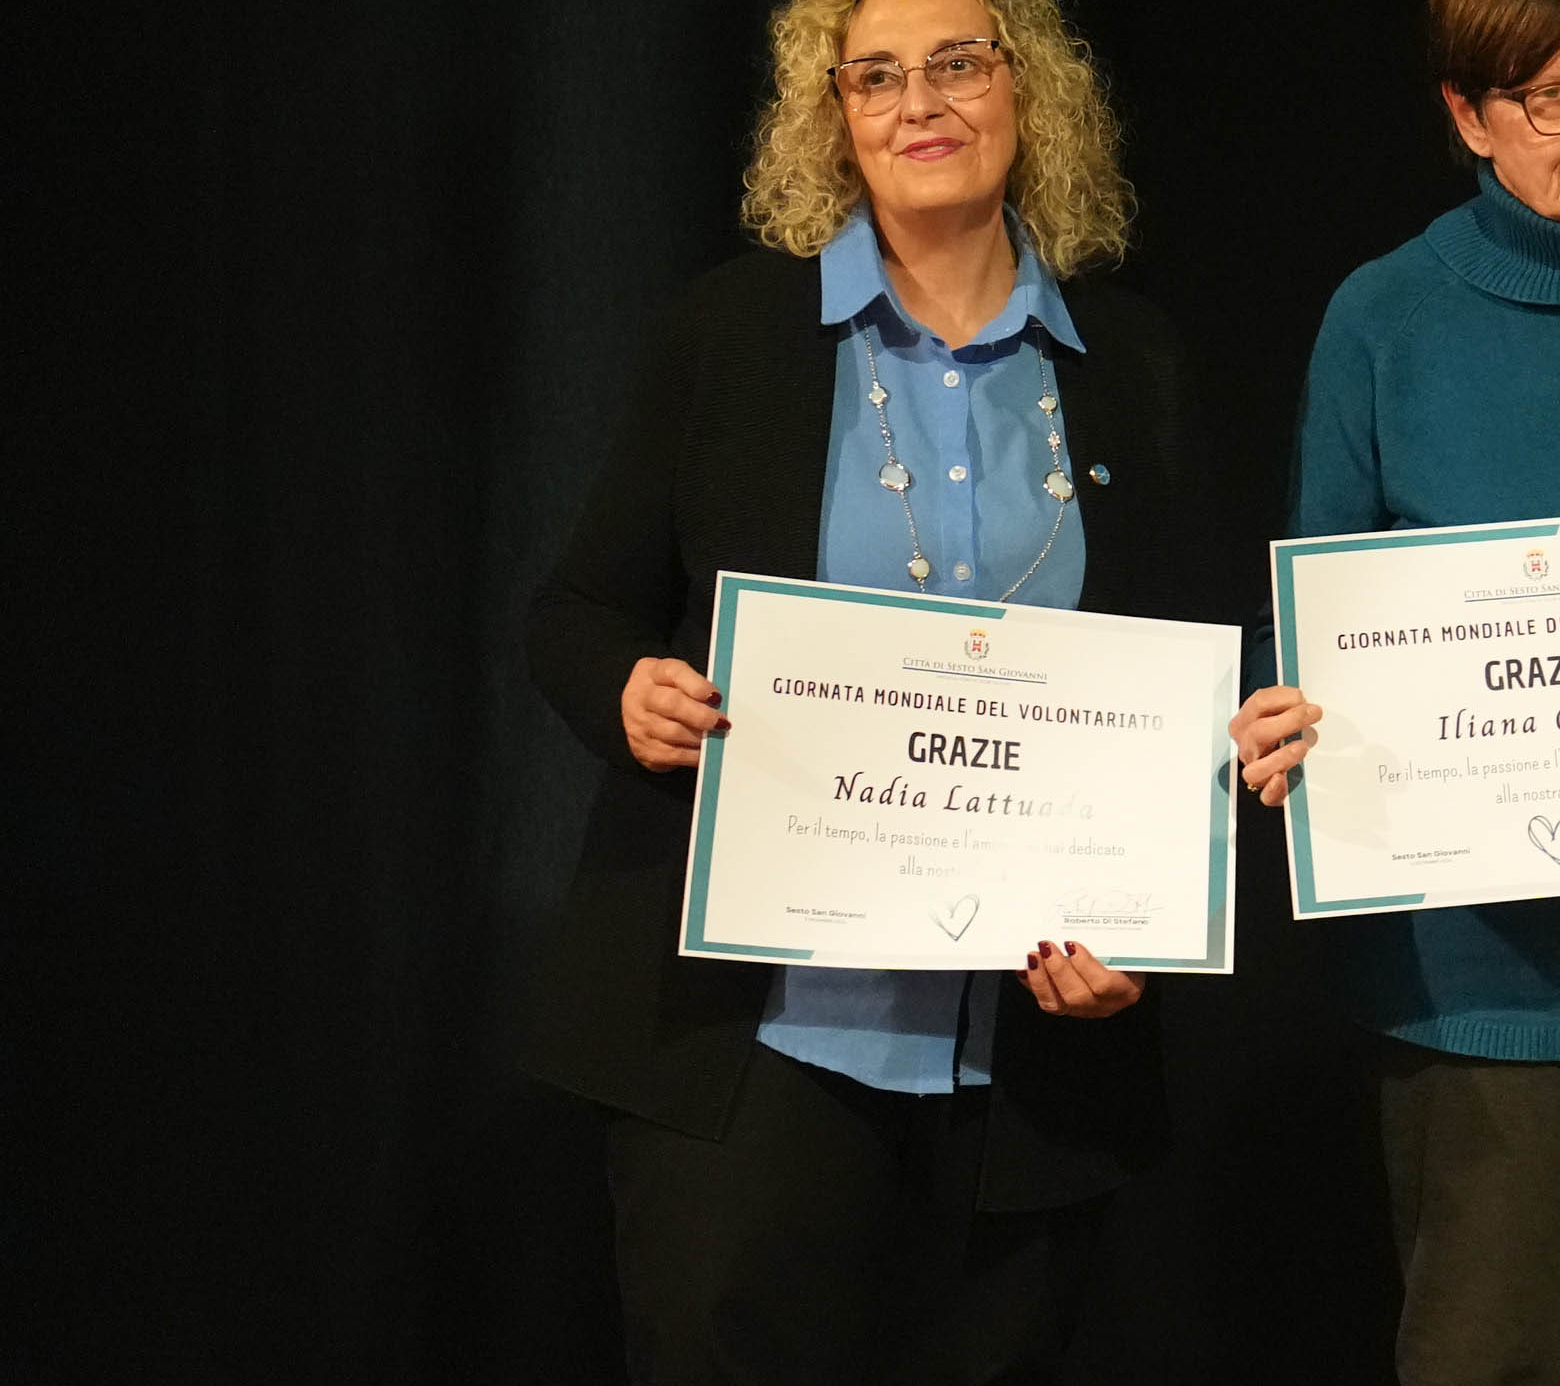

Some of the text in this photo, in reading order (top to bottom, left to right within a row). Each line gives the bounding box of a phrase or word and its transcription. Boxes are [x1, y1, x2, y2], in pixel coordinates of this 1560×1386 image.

[1337, 627, 1433, 651] GIORNATA
[1441, 618, 1537, 643] MONDIALE
[772, 677, 1164, 730] GIORNATA MONDIALE DEL VOLONTARIATO
[1438, 708, 1537, 741] Iliana
[907, 731, 1021, 772] GRAZIE
[1378, 764, 1402, 784] Per
[1403, 760, 1414, 782] il
[1416, 767, 1463, 784] tempo,
[1466, 756, 1480, 777] la
[1482, 758, 1541, 780] passione
[1542, 759, 1552, 770] e
[833, 771, 1094, 821] Nadia Lattuaa
[1495, 782, 1520, 805] alla
[787, 814, 811, 835] Per
[813, 816, 823, 837] il
[825, 824, 870, 845] tempo,
[874, 821, 887, 843] la
[890, 832, 948, 849] passione
[951, 838, 960, 849] e
[1067, 834, 1126, 860] dedicato
[898, 854, 923, 877] alla
